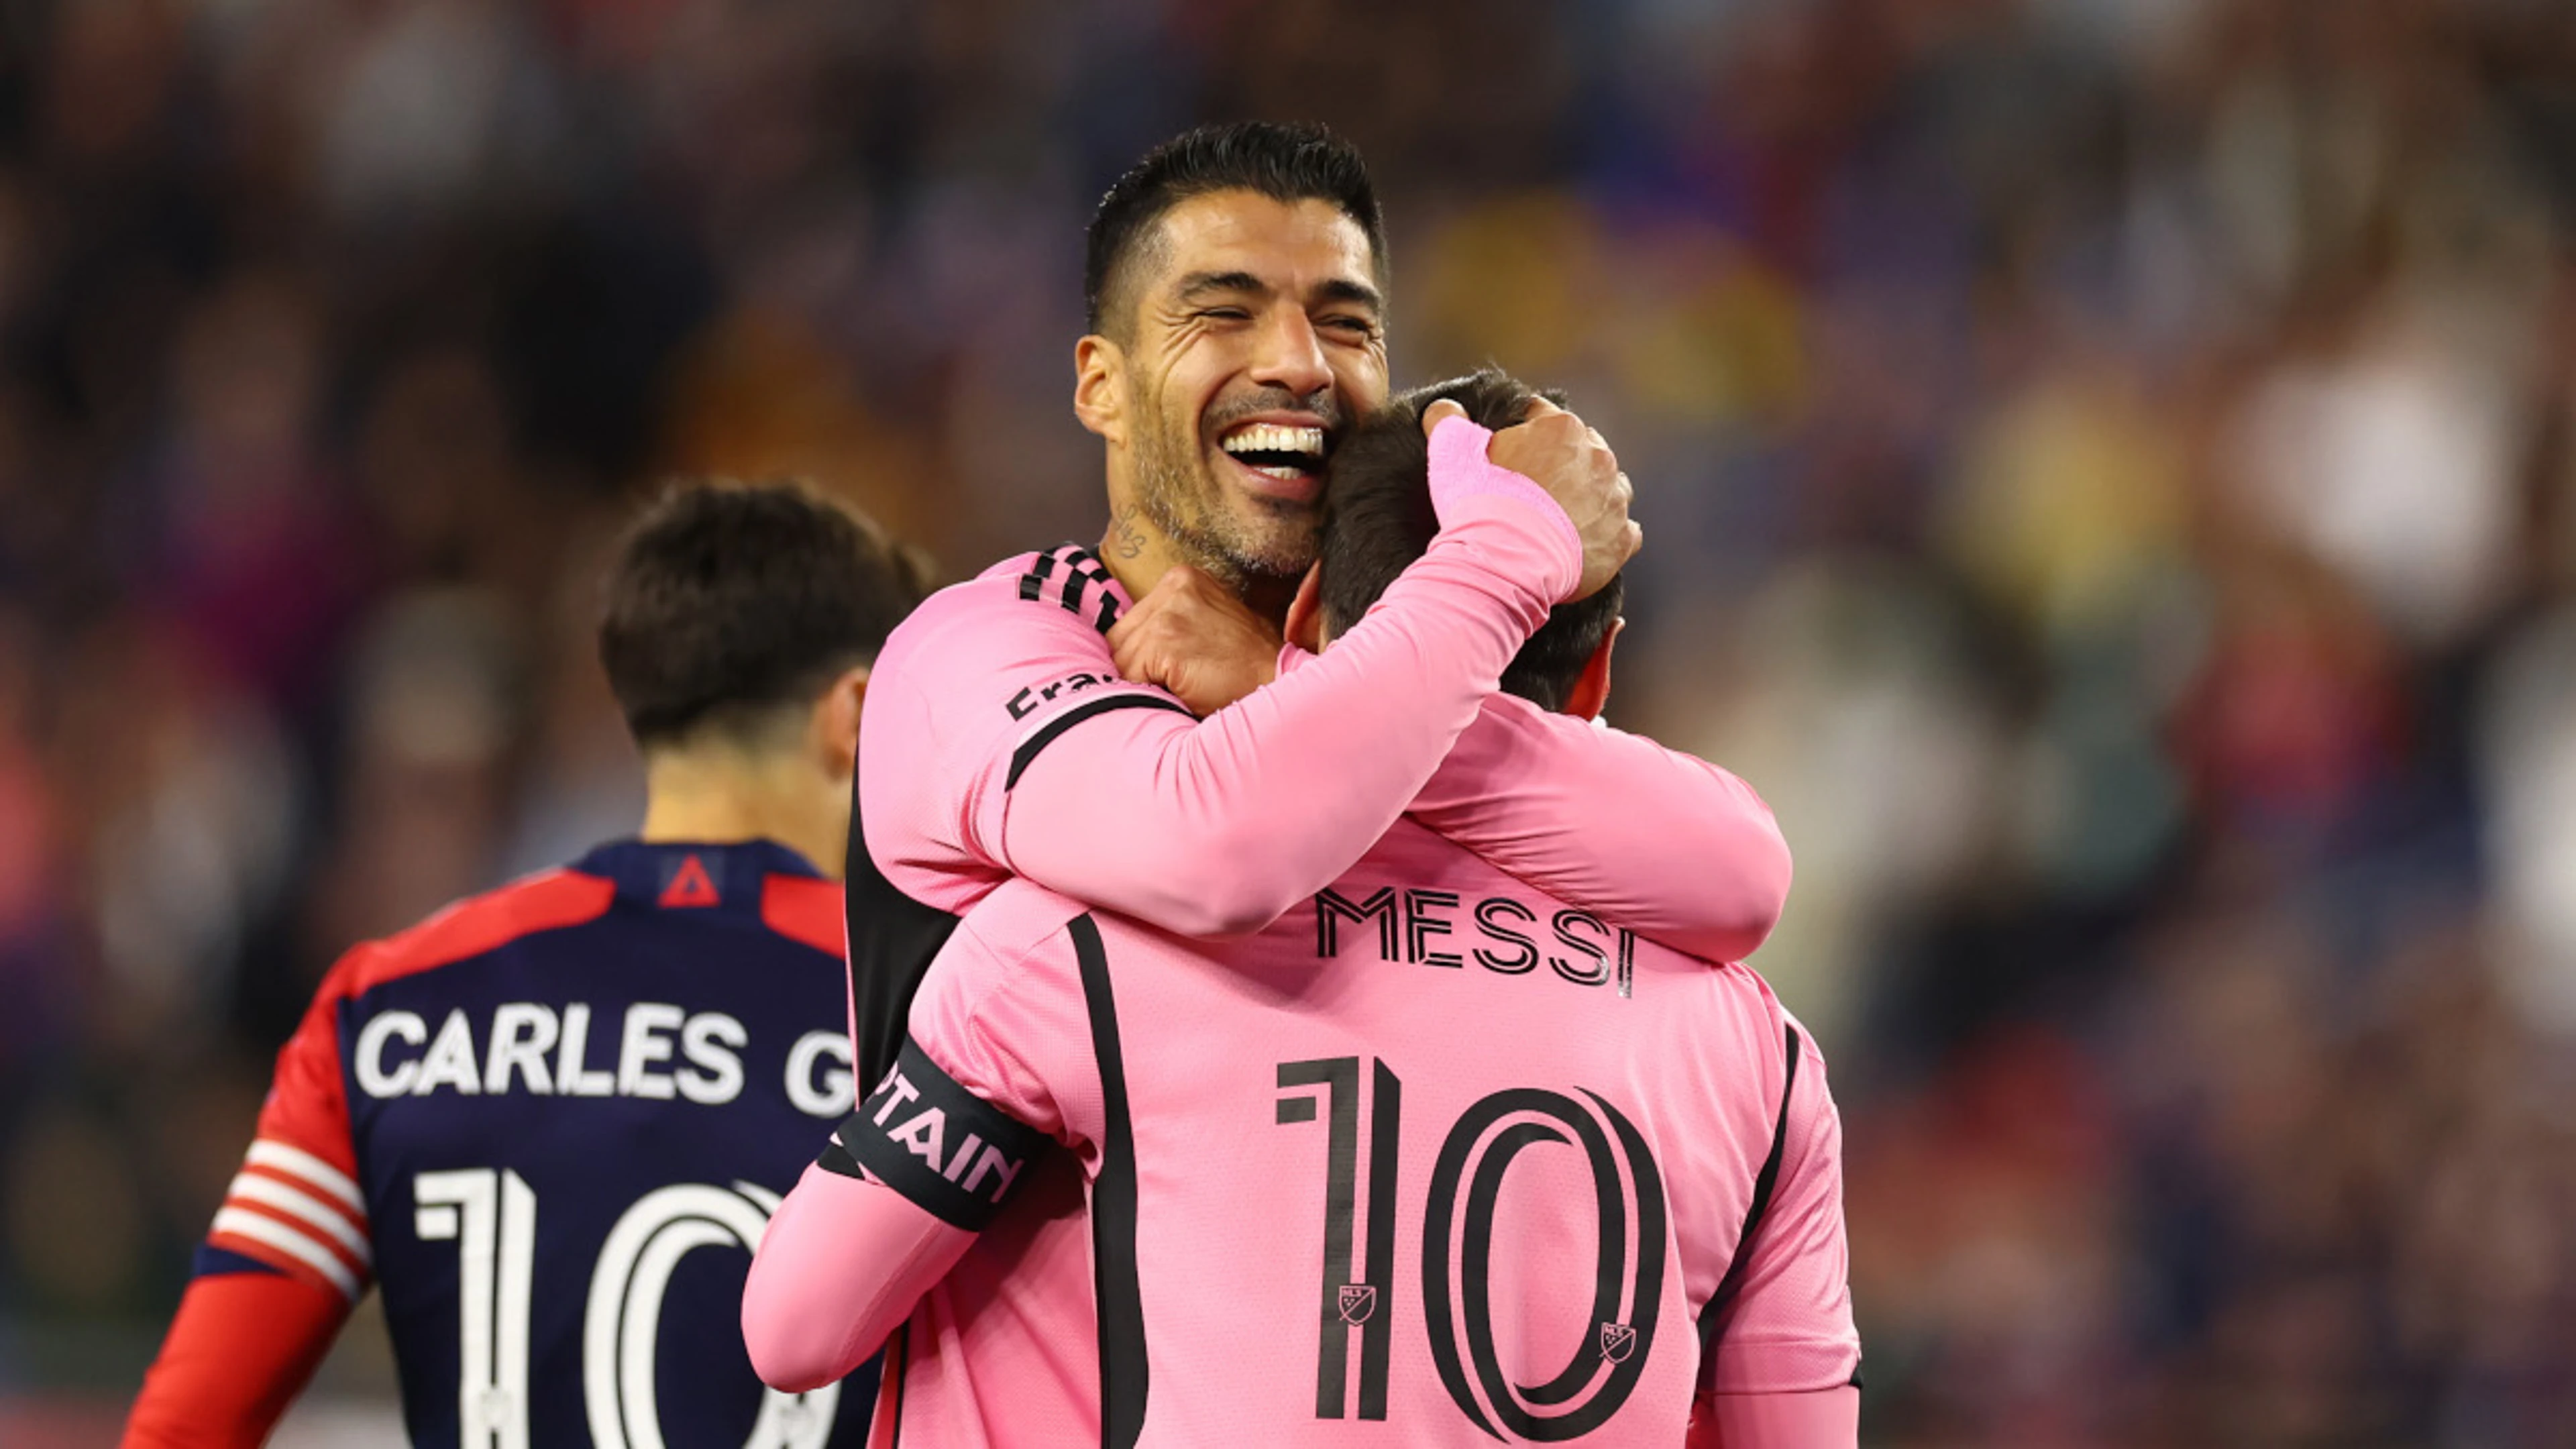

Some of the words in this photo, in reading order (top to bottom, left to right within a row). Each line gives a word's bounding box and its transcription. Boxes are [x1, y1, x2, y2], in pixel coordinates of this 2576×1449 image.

[1006, 673, 1112, 721] Fra
[1316, 887, 1634, 998] MESSI
[355, 1002, 747, 1106] CARLES
[785, 1029, 857, 1118] G
[413, 1167, 841, 1449] 10
[1276, 1056, 1667, 1445] 10
